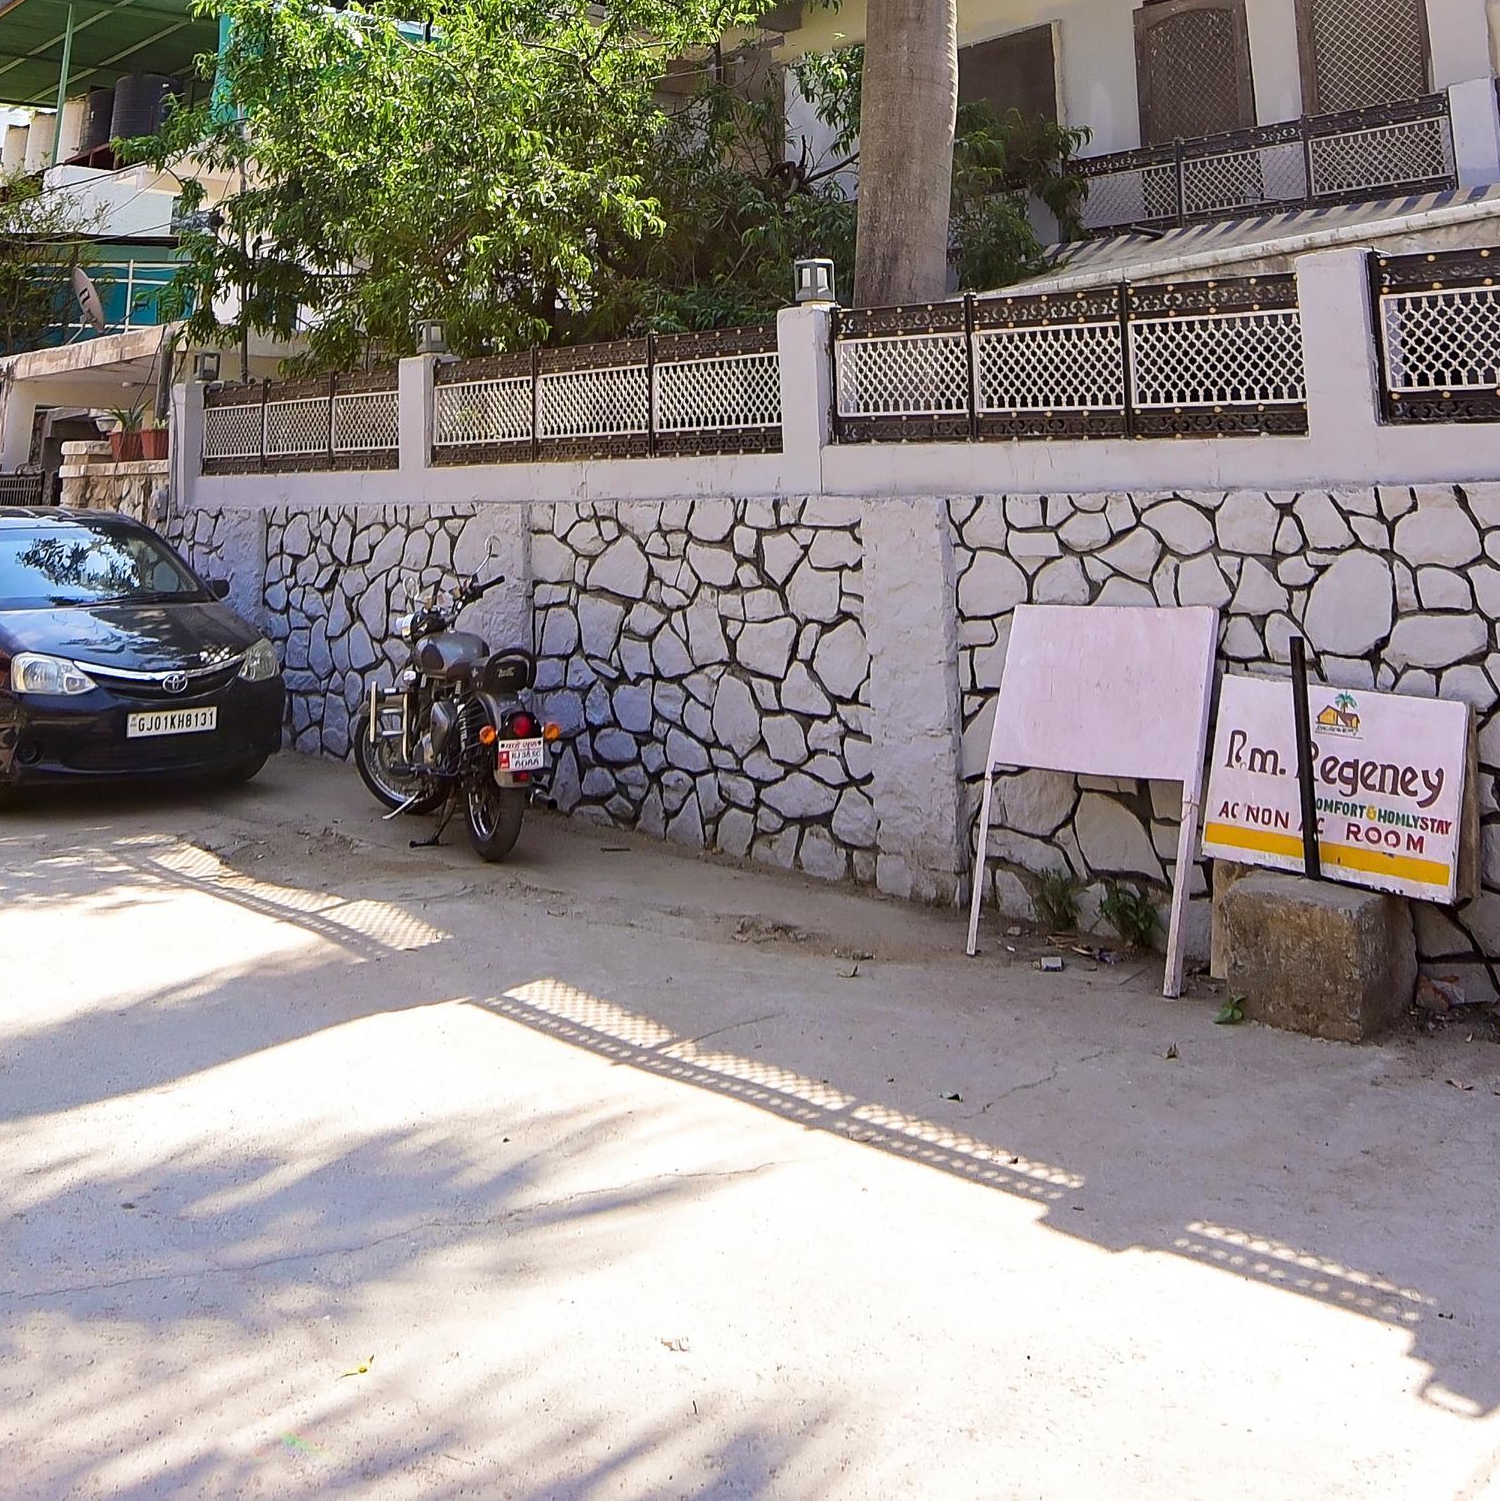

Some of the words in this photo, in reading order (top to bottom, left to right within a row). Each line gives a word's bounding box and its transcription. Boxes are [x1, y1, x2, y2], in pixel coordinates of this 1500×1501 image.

[138, 710, 214, 732] GJ01KH8131
[1315, 797, 1366, 819] OMFORT
[1245, 805, 1290, 830] NON
[1345, 822, 1425, 854] ROOM
